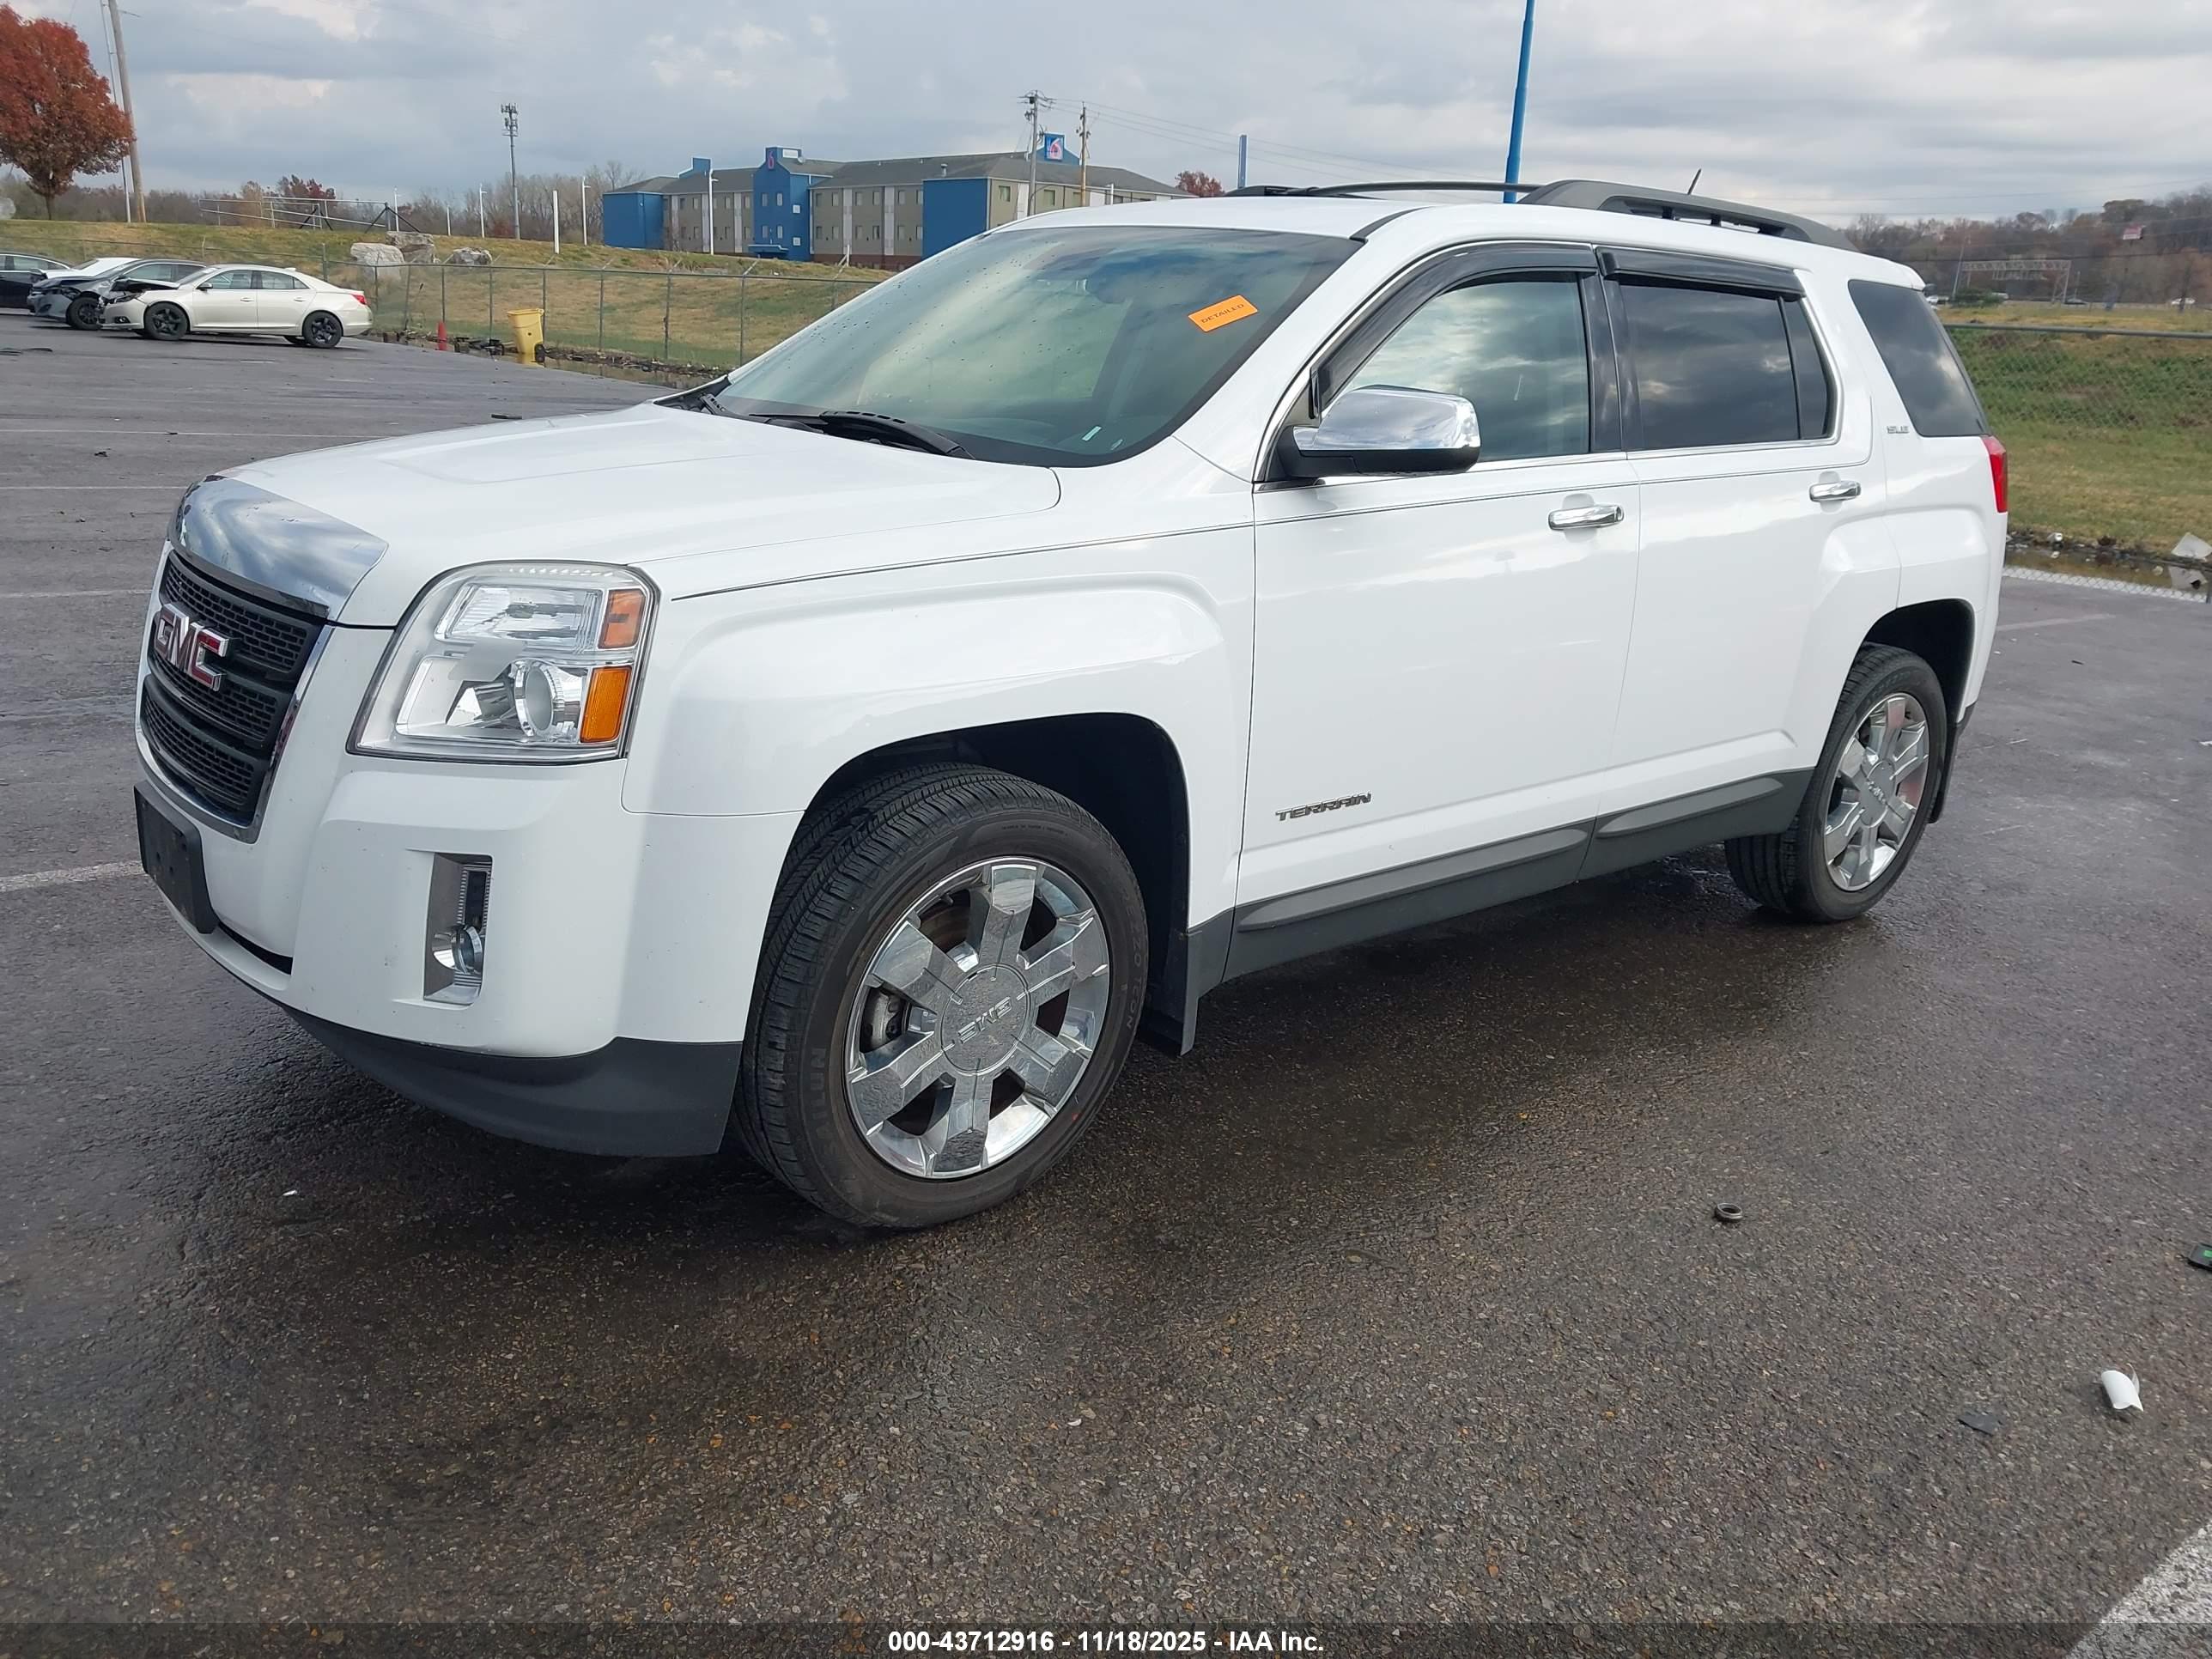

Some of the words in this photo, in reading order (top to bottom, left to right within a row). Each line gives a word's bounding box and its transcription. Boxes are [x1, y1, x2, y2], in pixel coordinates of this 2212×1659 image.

[768, 150, 775, 170] 6
[1200, 303, 1245, 324] DETAILED
[154, 603, 230, 692] GMC
[1275, 792, 1372, 822] TERRAIN
